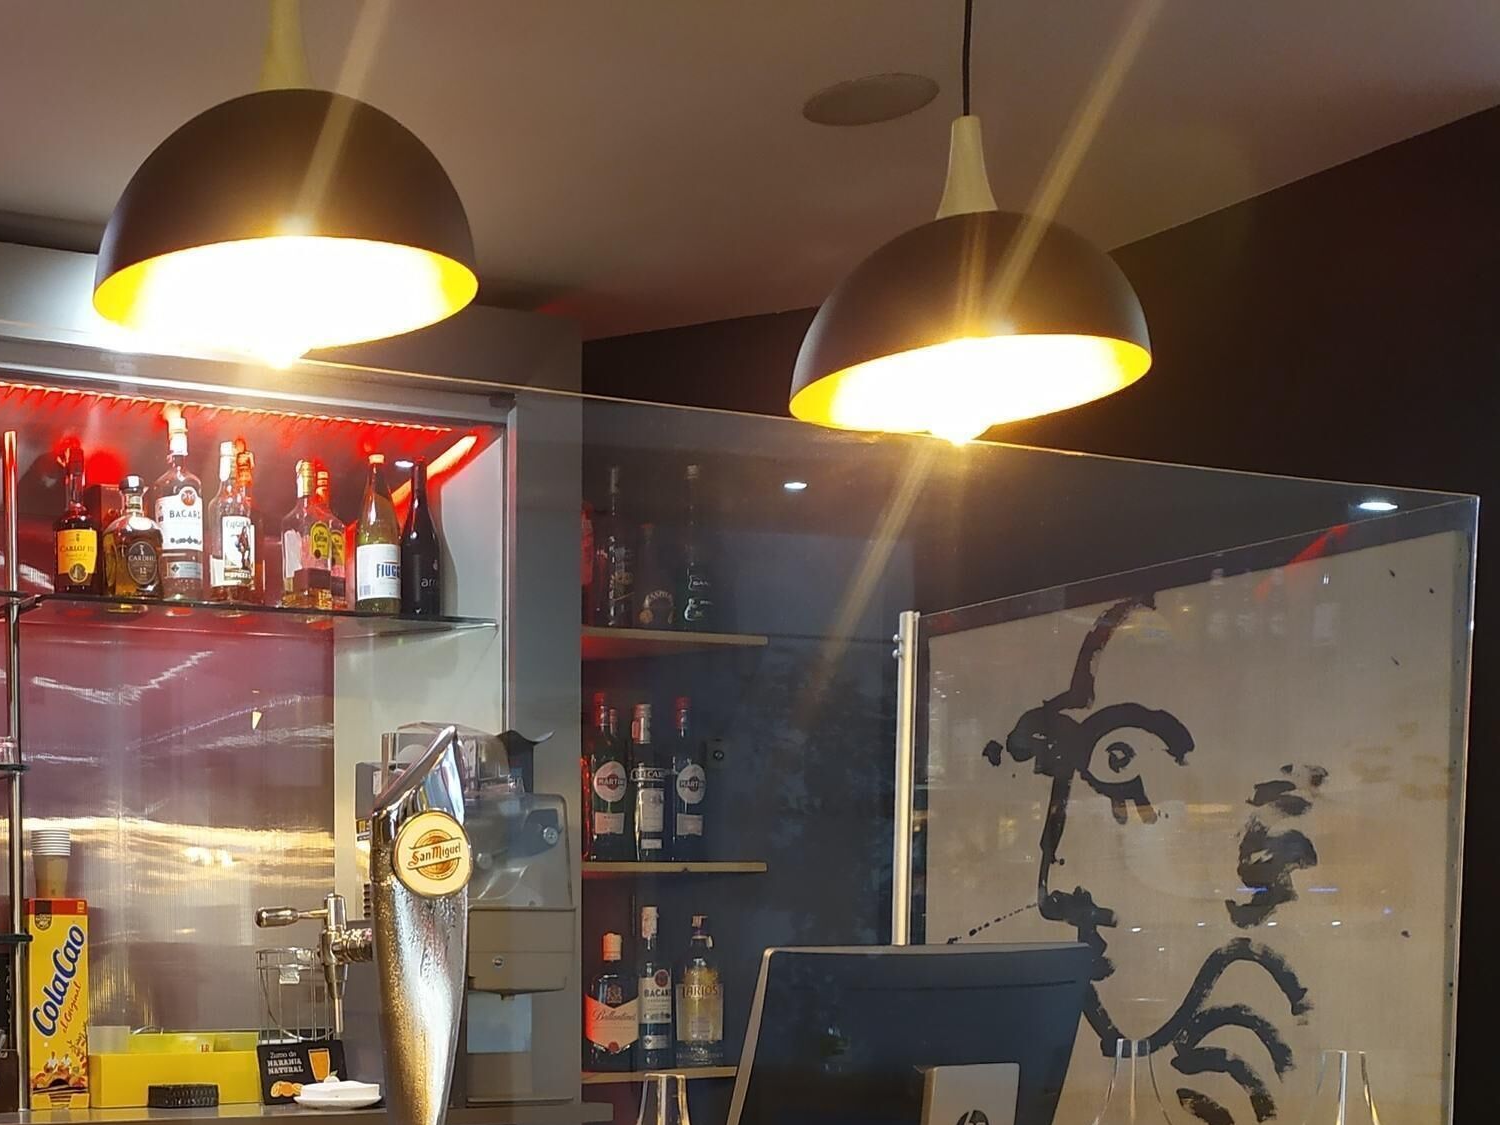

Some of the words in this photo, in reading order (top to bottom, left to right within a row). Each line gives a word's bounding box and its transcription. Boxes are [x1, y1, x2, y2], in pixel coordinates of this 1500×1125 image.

[408, 851, 431, 867] San
[431, 842, 461, 859] Miguel
[32, 925, 85, 1037] ColaCao
[268, 1066, 304, 1075] NATURAL
